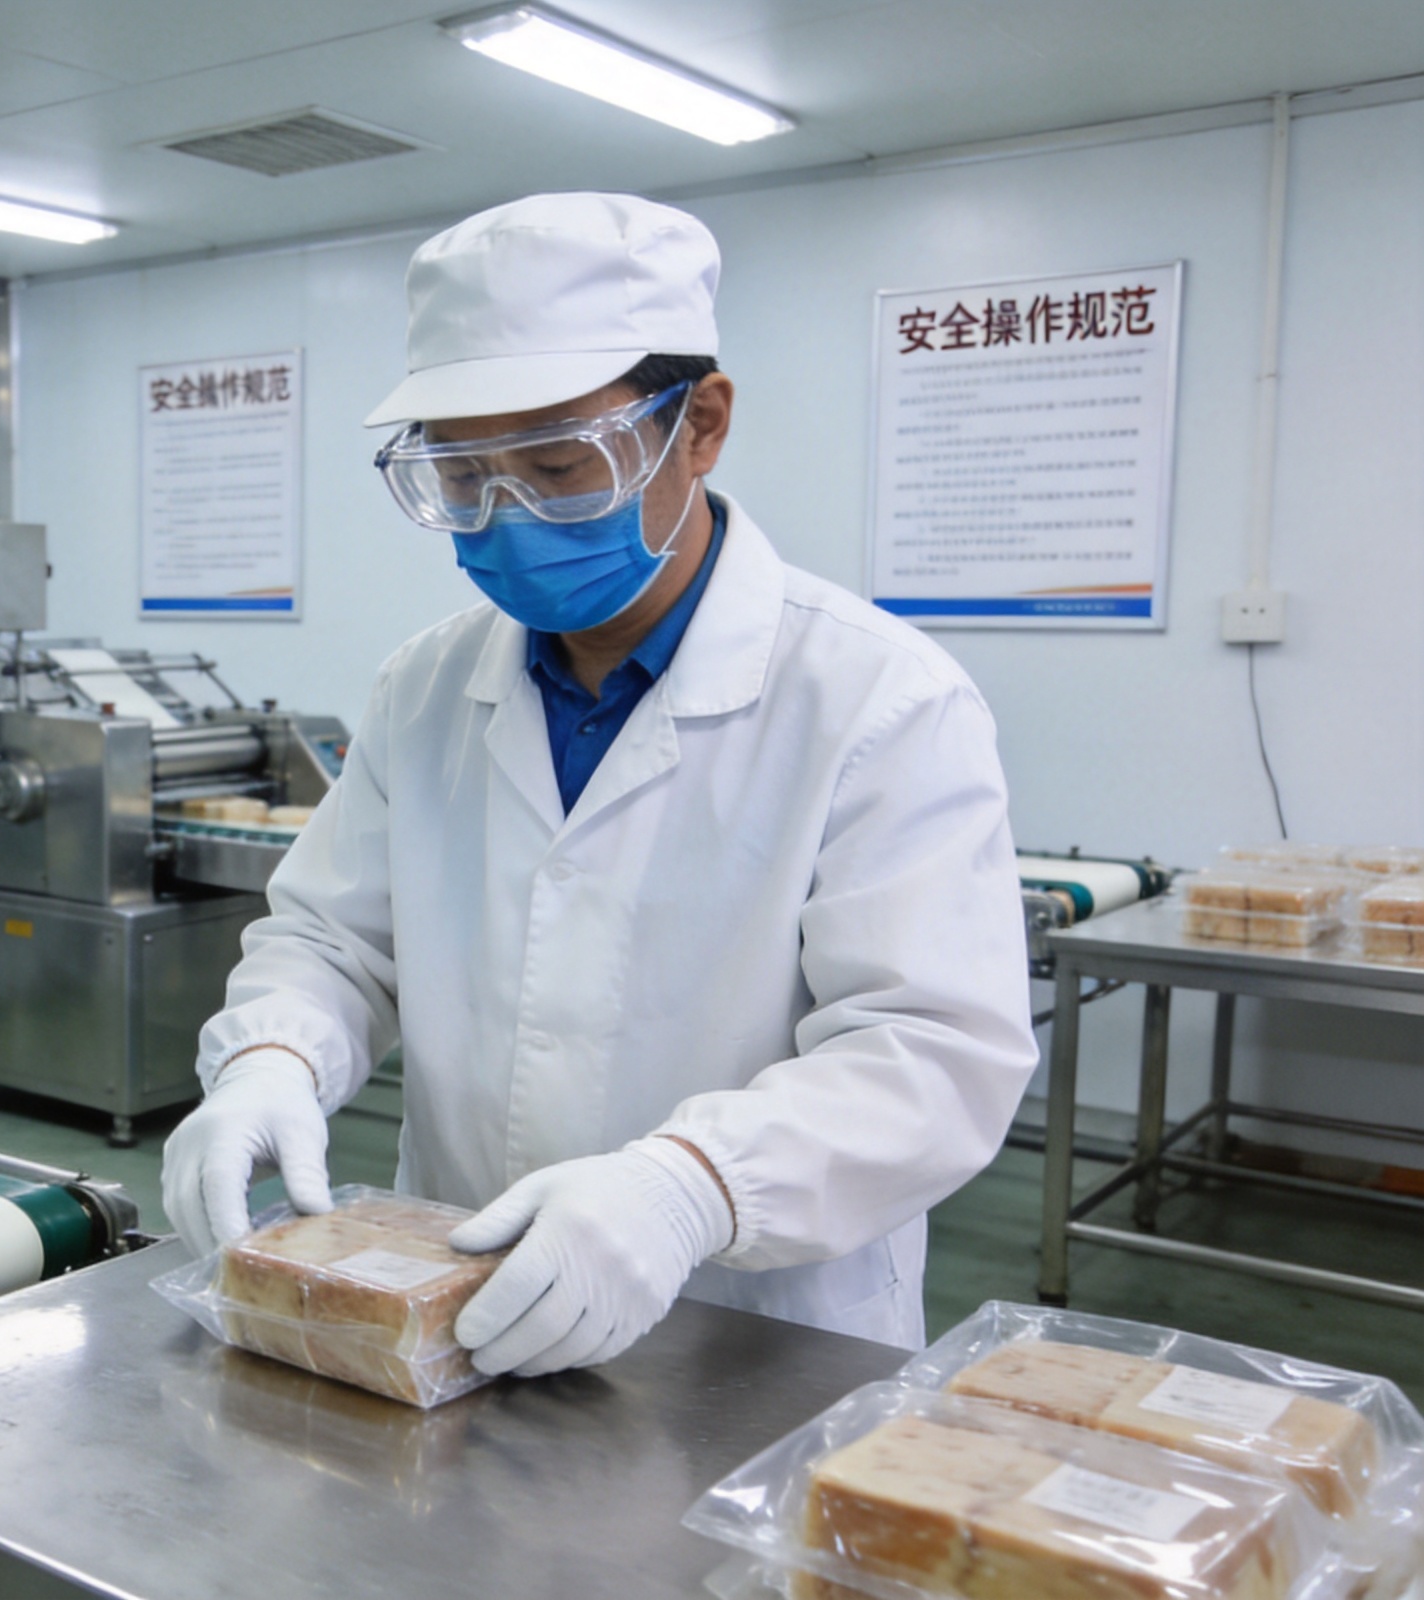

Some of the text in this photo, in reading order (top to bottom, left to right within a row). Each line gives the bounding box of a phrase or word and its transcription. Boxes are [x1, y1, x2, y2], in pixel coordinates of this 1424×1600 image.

[898, 285, 1156, 354] 安全操作规范
